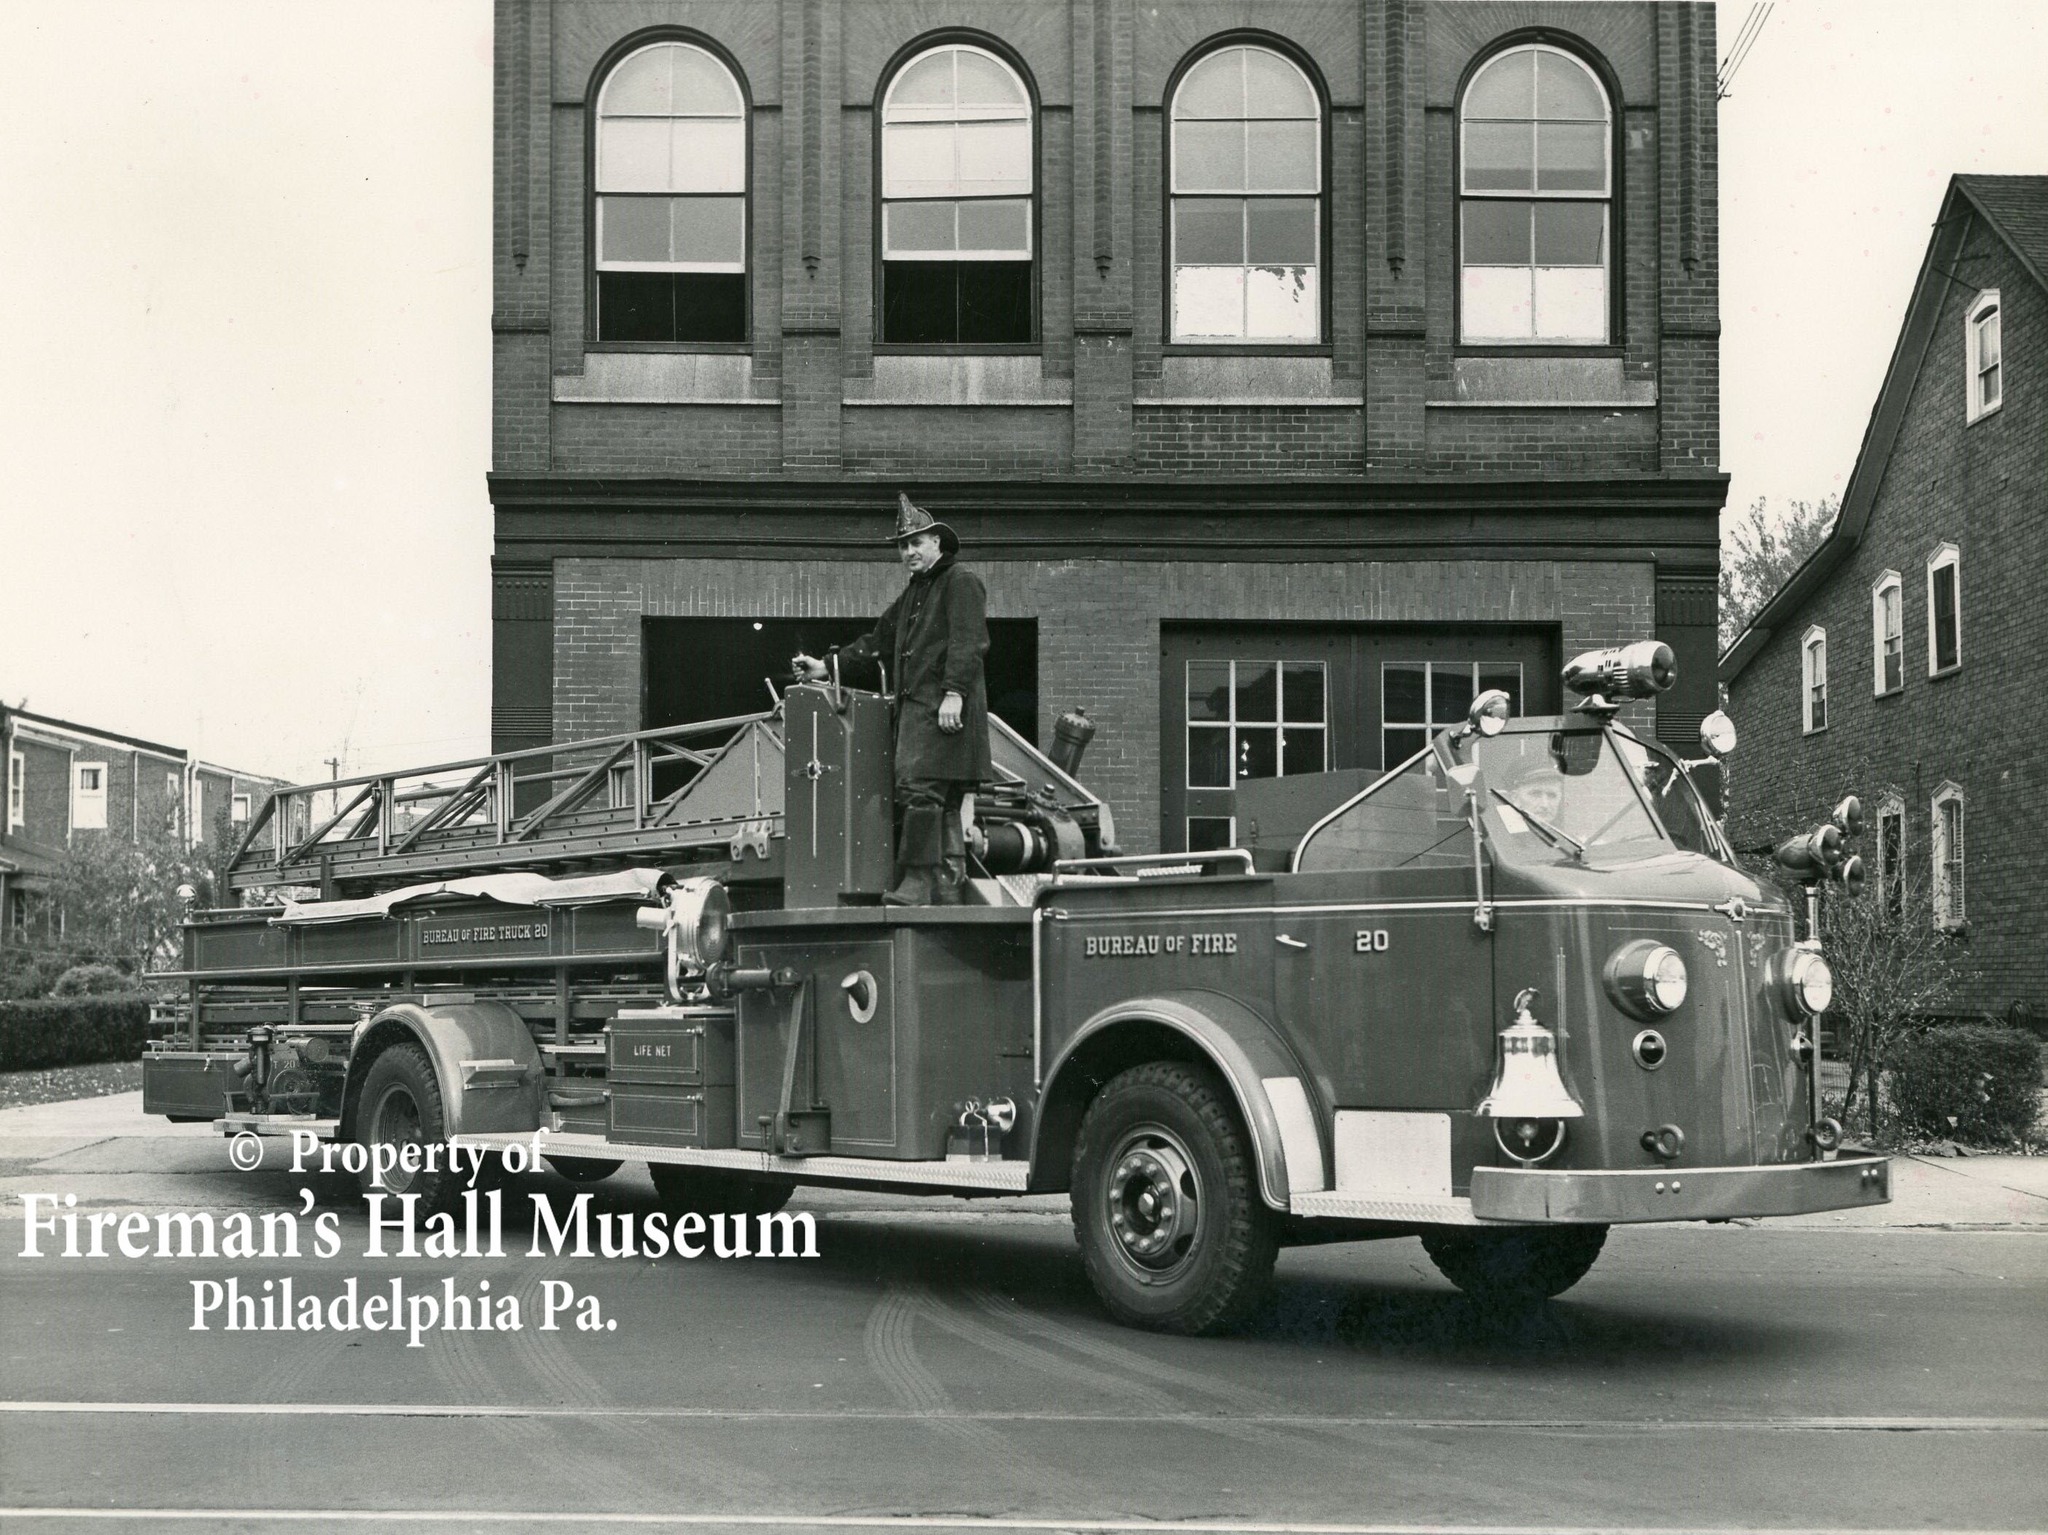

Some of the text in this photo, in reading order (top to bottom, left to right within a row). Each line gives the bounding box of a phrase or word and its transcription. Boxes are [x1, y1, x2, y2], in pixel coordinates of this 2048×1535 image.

[423, 923, 548, 944] BUREAU OF FIRE TRUCK 20
[1356, 929, 1389, 952] 20
[1086, 933, 1238, 956] BUREAU OF FIRE
[634, 1045, 671, 1057] LIFE NET
[283, 1060, 296, 1069] 20
